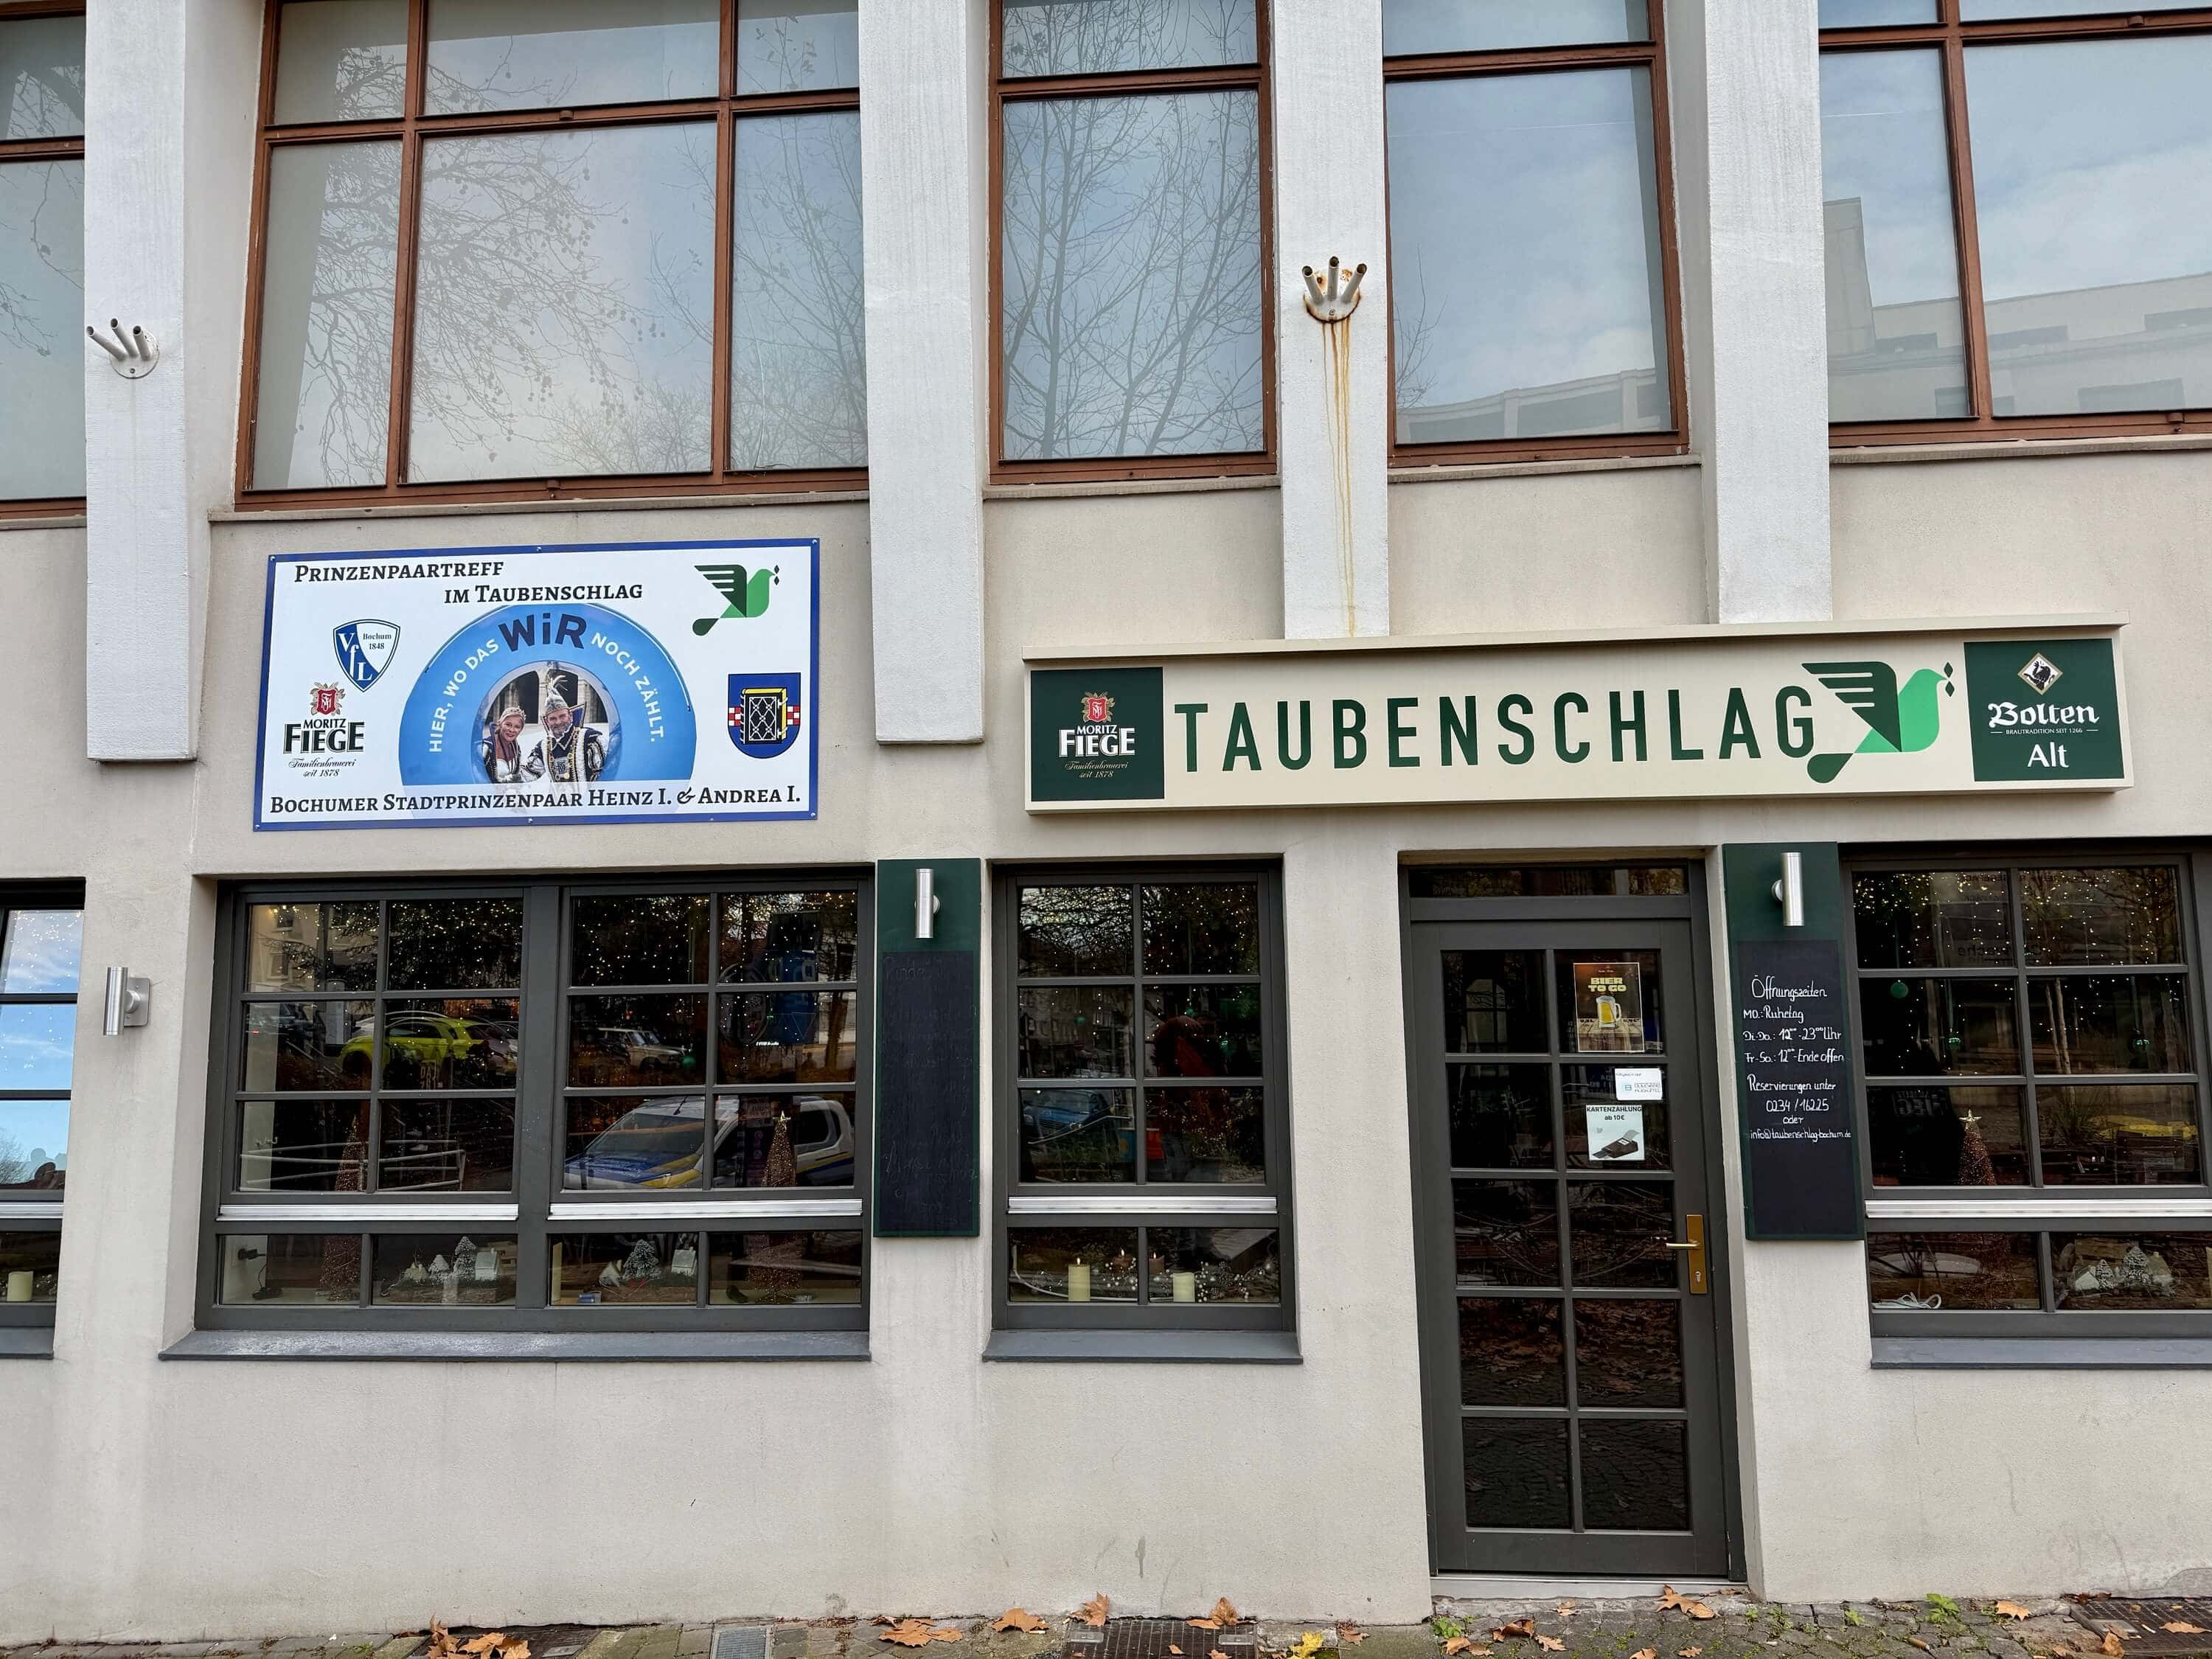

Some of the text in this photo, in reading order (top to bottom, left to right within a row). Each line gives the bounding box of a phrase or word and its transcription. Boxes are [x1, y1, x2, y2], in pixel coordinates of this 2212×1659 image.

[429, 702, 454, 753] HIER,
[443, 669, 467, 697] WO
[465, 638, 499, 671] DAS
[591, 632, 641, 676] NOCH
[635, 675, 664, 743] ZÄHLT.
[1987, 701, 2100, 728] Bolten
[303, 718, 347, 729] MORITZ
[1077, 724, 1118, 735] MORITZ
[1174, 684, 1815, 773] TAUBENSCHLAG
[2006, 727, 2055, 735] BRAUTRADITION
[283, 721, 365, 755] FIEGE
[1059, 727, 1136, 758] FIEGE
[2027, 741, 2070, 768] Alt
[288, 757, 357, 768] Familienbrauerei
[1064, 759, 1130, 771] Familienbrauerei
[303, 768, 340, 778] seit 1878
[1079, 770, 1114, 779] seit 1878
[657, 787, 672, 805] I.
[676, 786, 696, 805] &
[786, 785, 801, 803] I.
[1587, 984, 1627, 992] TO GO
[1590, 977, 1623, 985] BIER
[1750, 974, 1828, 1002] Öffnungszeiten
[1764, 1004, 1804, 1024] Ruhetag
[1823, 1026, 1842, 1040] Uhr
[1820, 1047, 1845, 1063] offen
[1747, 1074, 1837, 1094] Reservierungen unter
[1782, 1114, 1804, 1124] oder
